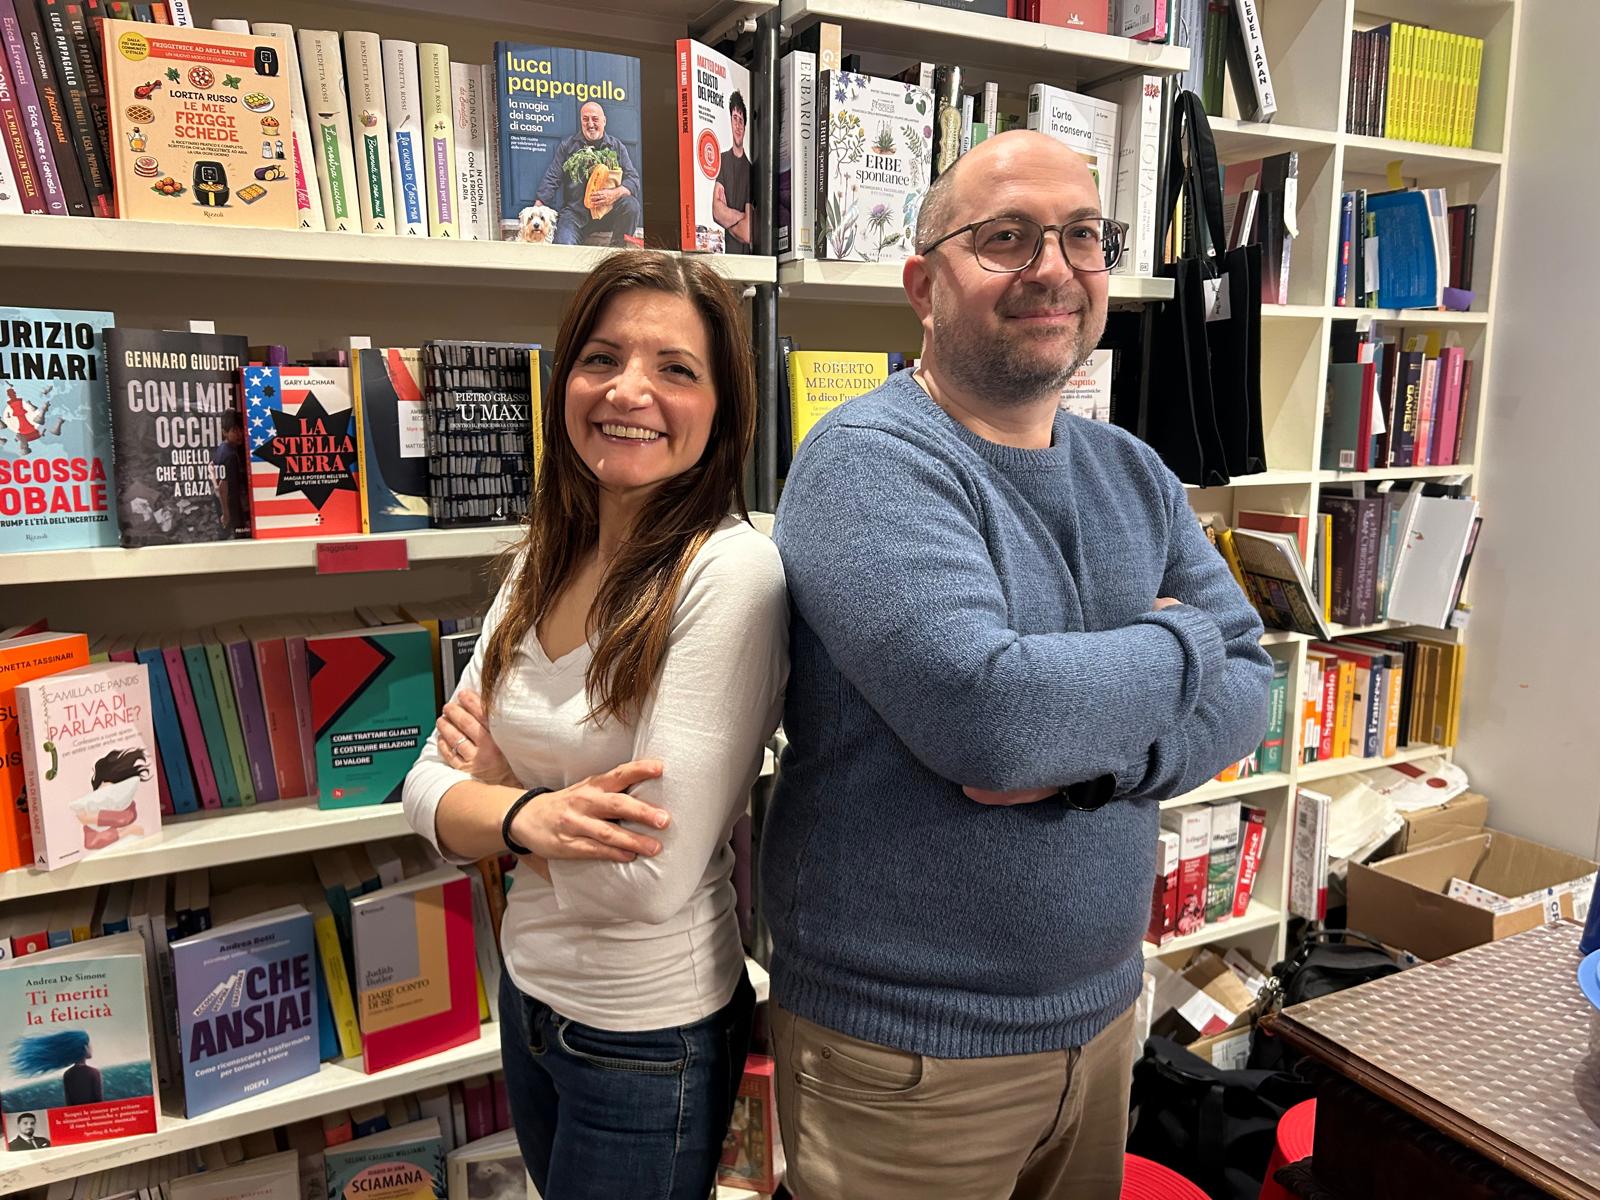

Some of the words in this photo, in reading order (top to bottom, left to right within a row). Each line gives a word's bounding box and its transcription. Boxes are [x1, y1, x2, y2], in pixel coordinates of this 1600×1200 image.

[50, 12, 63, 32] LUCA
[1244, 1, 1257, 40] LEVEL
[1254, 46, 1267, 84] JAPAN
[56, 36, 77, 86] PAPPAGALLO
[506, 51, 552, 75] luca
[508, 76, 626, 102] pappagallo
[697, 69, 702, 84] IL
[702, 71, 719, 91] GUSTO
[169, 90, 205, 101] LORITA
[207, 93, 238, 103] RUSSO
[468, 78, 477, 105] FATTO
[697, 84, 707, 102] DEL
[800, 61, 811, 140] ERBARIO
[183, 101, 198, 111] LE
[201, 103, 226, 113] MIE
[469, 106, 476, 115] IN
[509, 98, 518, 109] la
[519, 101, 549, 112] magia
[1051, 106, 1072, 122] L'orto
[5, 109, 13, 120] LA
[175, 111, 236, 128] FRIGGI
[509, 110, 524, 120] dei
[525, 112, 555, 124] sapori
[9, 120, 18, 136] MIA
[175, 125, 240, 142] SCHEDE
[470, 116, 478, 140] CASA
[509, 120, 519, 130] di
[520, 123, 543, 133] casa
[1051, 121, 1058, 132] in
[1059, 125, 1092, 140] conserva
[14, 137, 24, 160] PIZZA
[19, 160, 28, 169] IN
[866, 154, 902, 172] ERBE
[462, 172, 468, 183] AD
[468, 169, 475, 178] LA
[22, 169, 35, 197] TEGLIA
[476, 178, 485, 206] CUCINA
[469, 180, 478, 224] FRIGGITRICE
[124, 351, 187, 370] GENNARO
[191, 354, 240, 371] GIUDETTI
[813, 362, 874, 374] ROBERTO
[283, 378, 301, 387] GARY
[303, 378, 335, 386] LACHMAN
[127, 379, 177, 413] CON
[183, 381, 190, 413] I
[455, 392, 492, 402] PIETRO
[493, 392, 530, 402] GRASSO
[807, 392, 817, 402] Io
[818, 392, 838, 402] dico
[480, 403, 530, 421] MAXI
[1403, 384, 1415, 432] GAMES
[155, 416, 224, 448] OCCHI
[299, 417, 328, 435] LA
[272, 435, 355, 456] STELLA
[171, 450, 210, 466] QUELLO
[285, 454, 346, 474] NERA
[156, 466, 178, 482] CHE
[180, 466, 195, 481] HO
[199, 465, 226, 481] VISTO
[174, 483, 181, 497] A
[184, 481, 212, 497] GAZA
[30, 516, 49, 526] L'ETÀ
[49, 515, 109, 525] DELL'INCERTEZZA
[33, 652, 74, 666] TASSINARI
[45, 686, 94, 704] CAMILLA
[94, 683, 106, 694] DE
[107, 674, 140, 690] PANDIS
[63, 703, 78, 721] TI
[81, 698, 109, 717] VA
[112, 693, 126, 711] DI
[1322, 674, 1337, 736] Spagnolo
[48, 705, 142, 741] PARLARNE?
[332, 734, 353, 743] COME
[354, 731, 388, 740] TRATTARE
[399, 727, 418, 736] ALTRI
[339, 744, 378, 754] COSTRUIRE
[379, 740, 415, 750] RELAZIONI
[334, 759, 342, 767] DI
[343, 756, 371, 766] VALORE
[1240, 832, 1259, 884] Inglese
[220, 940, 252, 953] Andrea
[25, 975, 58, 987] Andrea
[60, 974, 73, 983] De
[75, 971, 106, 982] Simone
[246, 953, 310, 1001] CHE
[366, 965, 394, 978] Judith
[25, 990, 48, 1006] Ti
[55, 983, 109, 1004] meriti
[367, 987, 394, 1002] DARE
[395, 978, 431, 994] CONTO
[27, 1009, 43, 1026] la
[50, 1003, 113, 1024] felicità
[190, 990, 312, 1063] ANSIA!
[194, 1065, 220, 1078] Come
[217, 1051, 261, 1070] riconoscerla
[268, 1034, 311, 1053] trasformarla
[220, 1068, 233, 1078] per
[234, 1061, 261, 1073] tornare
[267, 1051, 289, 1063] vivere
[243, 1077, 270, 1093] HOEPLI
[351, 1169, 423, 1193] SCIAMANA
